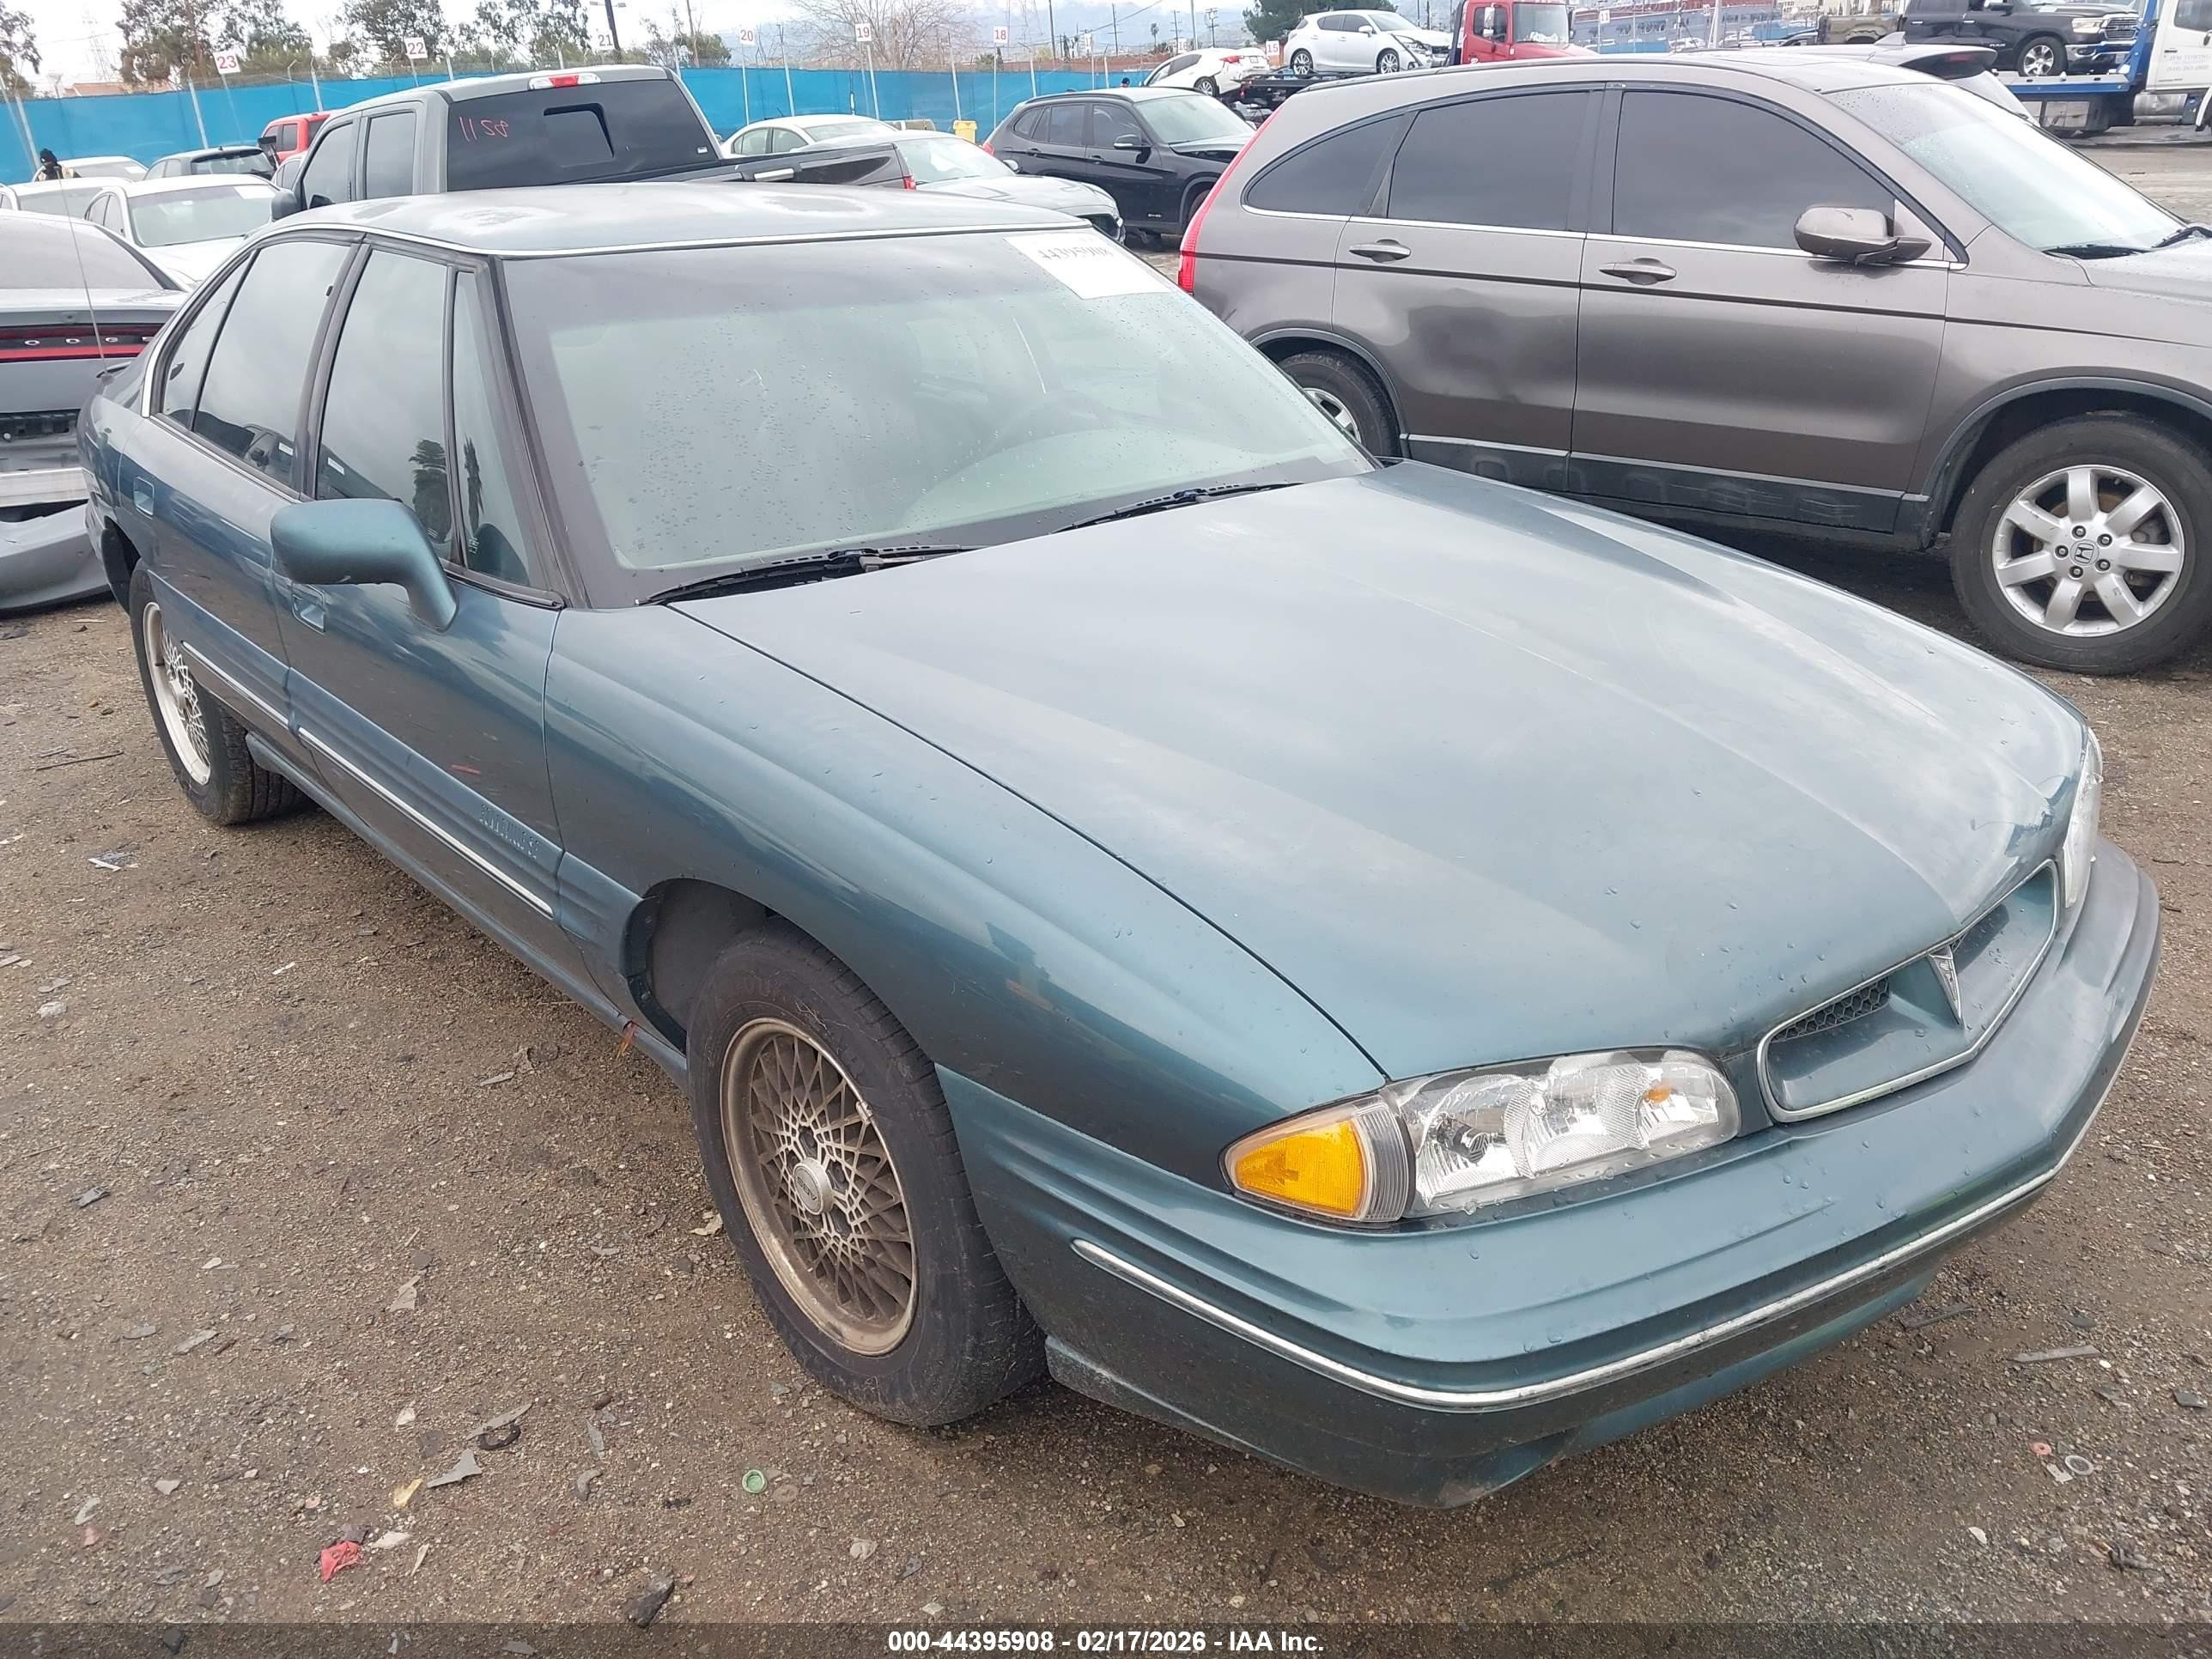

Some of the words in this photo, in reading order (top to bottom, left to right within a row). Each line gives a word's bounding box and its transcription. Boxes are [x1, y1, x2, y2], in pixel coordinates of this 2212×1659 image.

[598, 33, 613, 46] 21
[740, 29, 753, 42] 20
[857, 27, 870, 39] 19
[995, 29, 1006, 40] 18
[408, 42, 426, 55] 22
[1267, 43, 1279, 52] 15
[216, 55, 237, 70] 23
